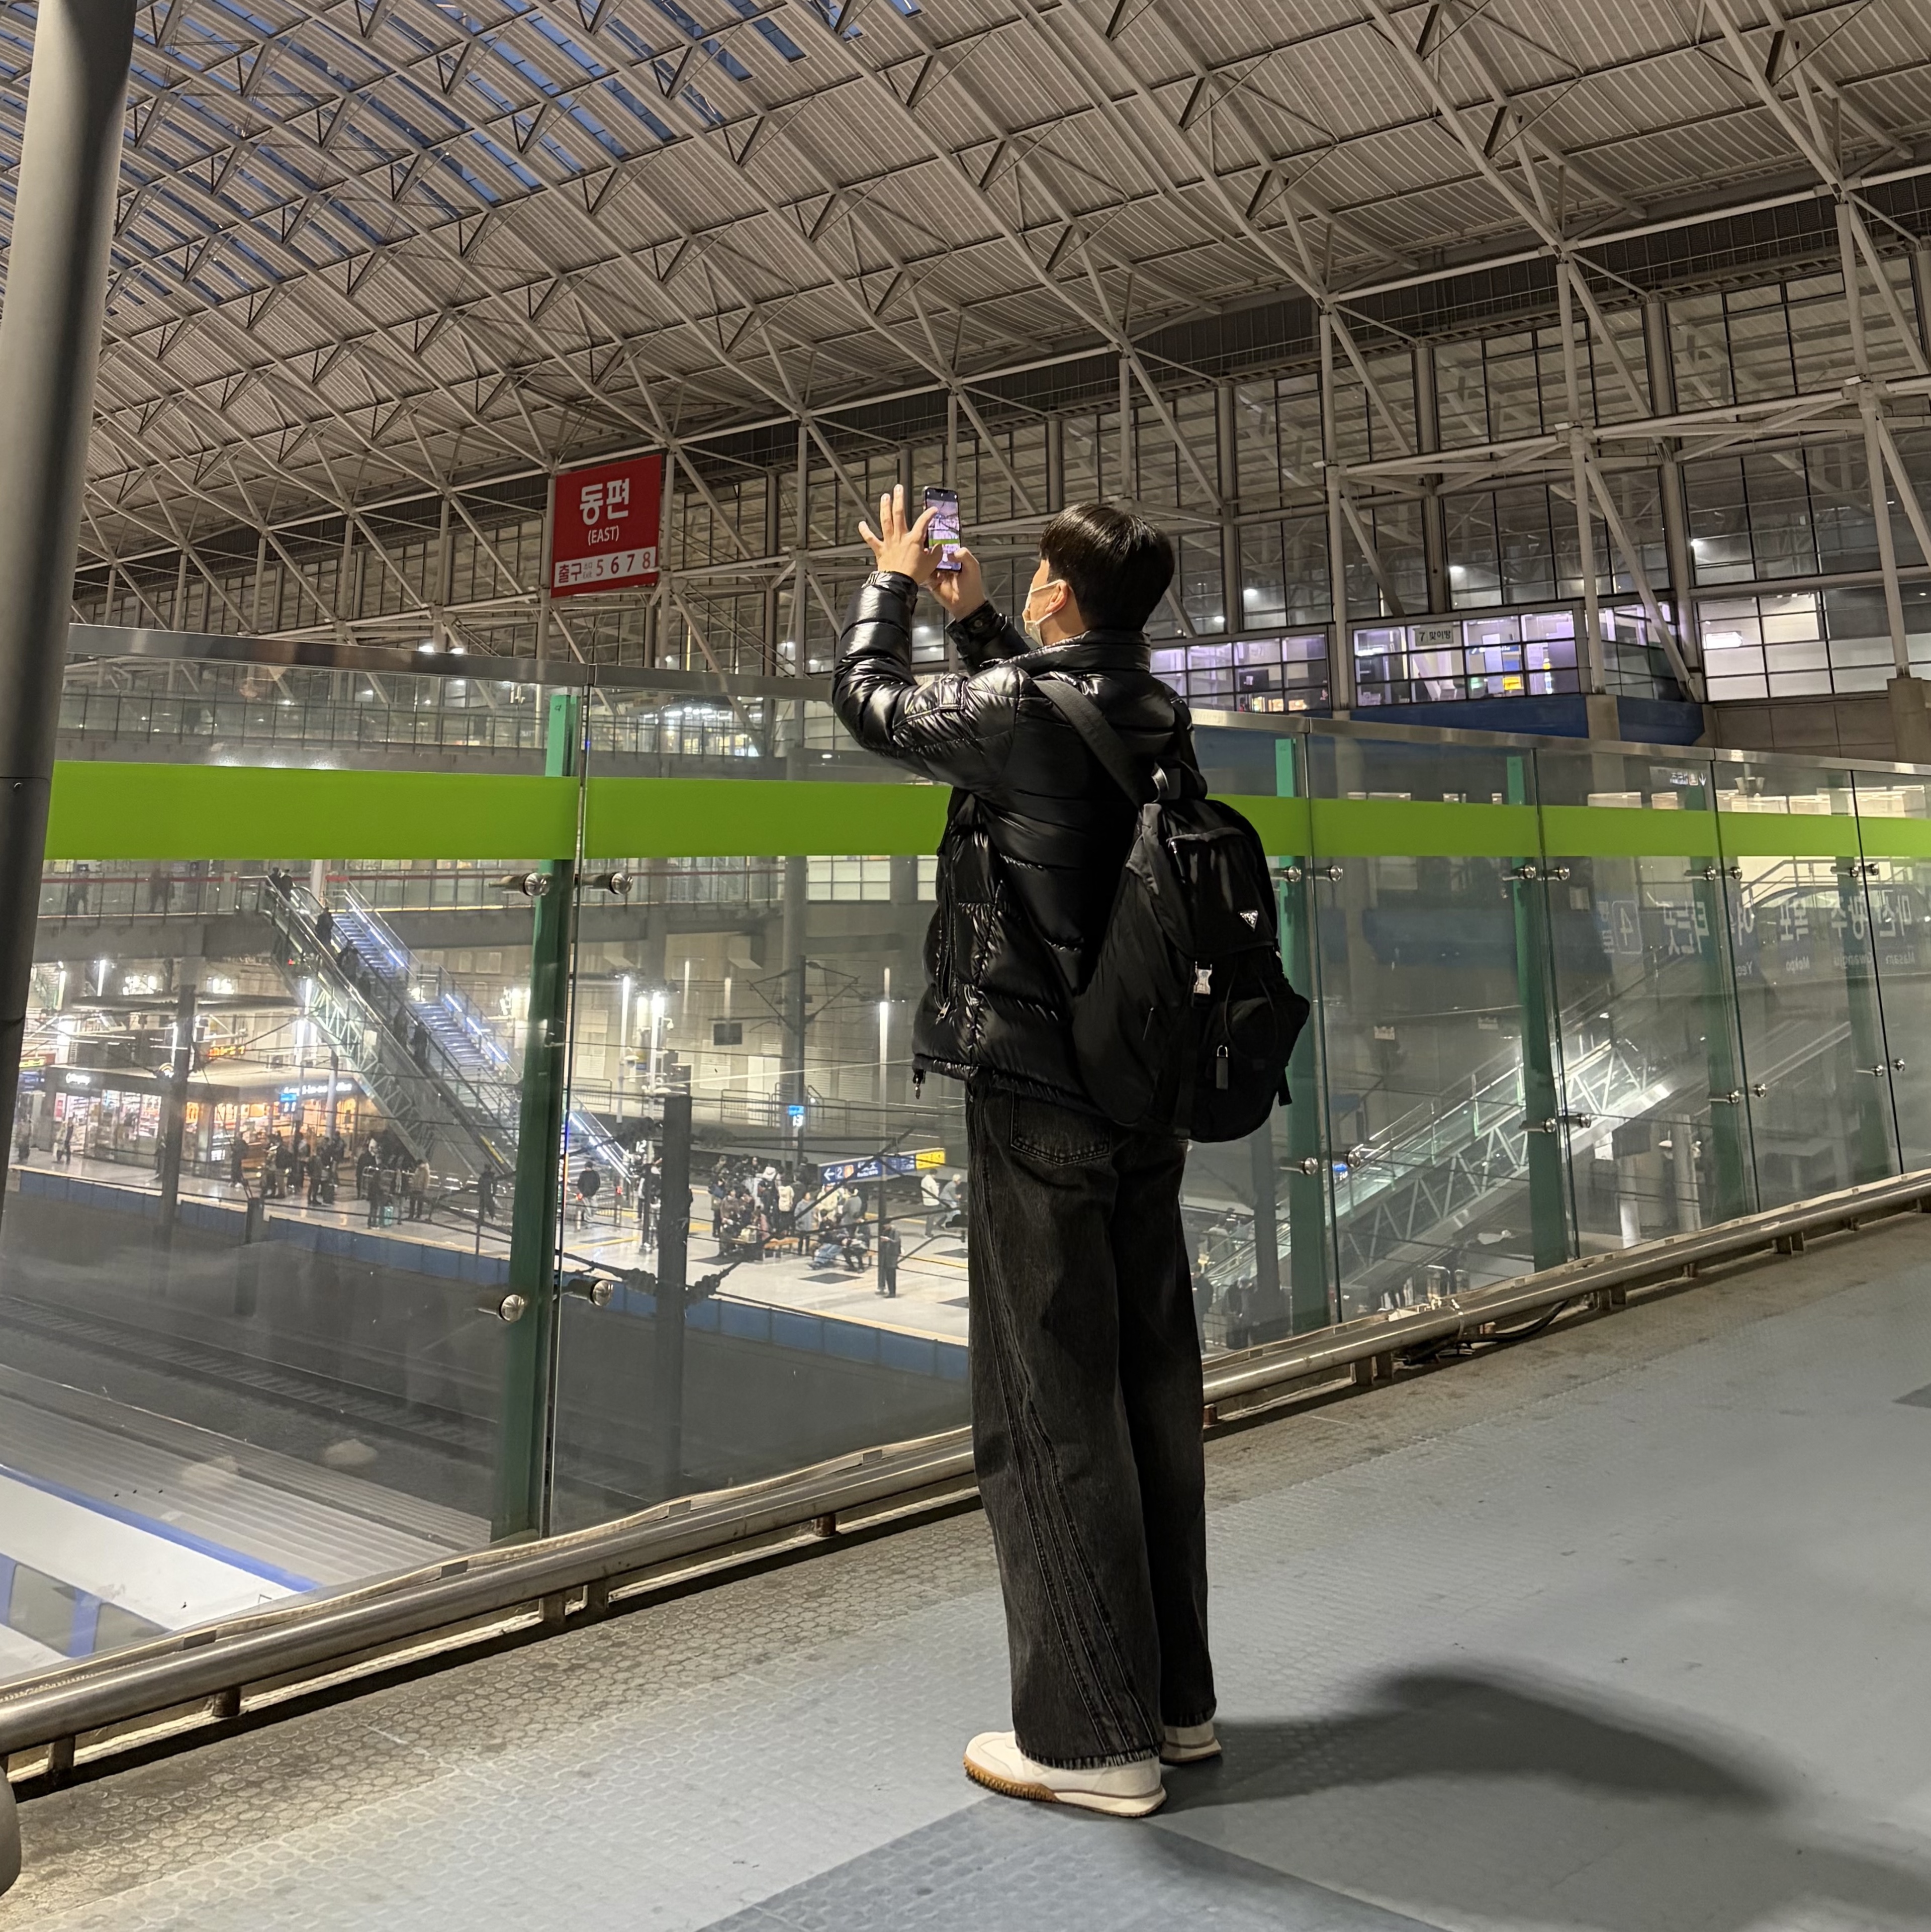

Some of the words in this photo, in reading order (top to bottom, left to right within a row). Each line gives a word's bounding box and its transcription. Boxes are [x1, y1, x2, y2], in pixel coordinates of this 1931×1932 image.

[580, 478, 629, 525] 동편
[588, 525, 619, 546] (EAST)
[559, 563, 582, 583] 출구
[596, 559, 604, 577] 5
[610, 556, 619, 574] 6
[627, 554, 635, 572] 7
[642, 551, 651, 570] 8
[1419, 631, 1425, 641] 7
[1429, 630, 1451, 640] 맞이방
[635, 1140, 647, 1153] 12
[837, 1167, 843, 1178] 2
